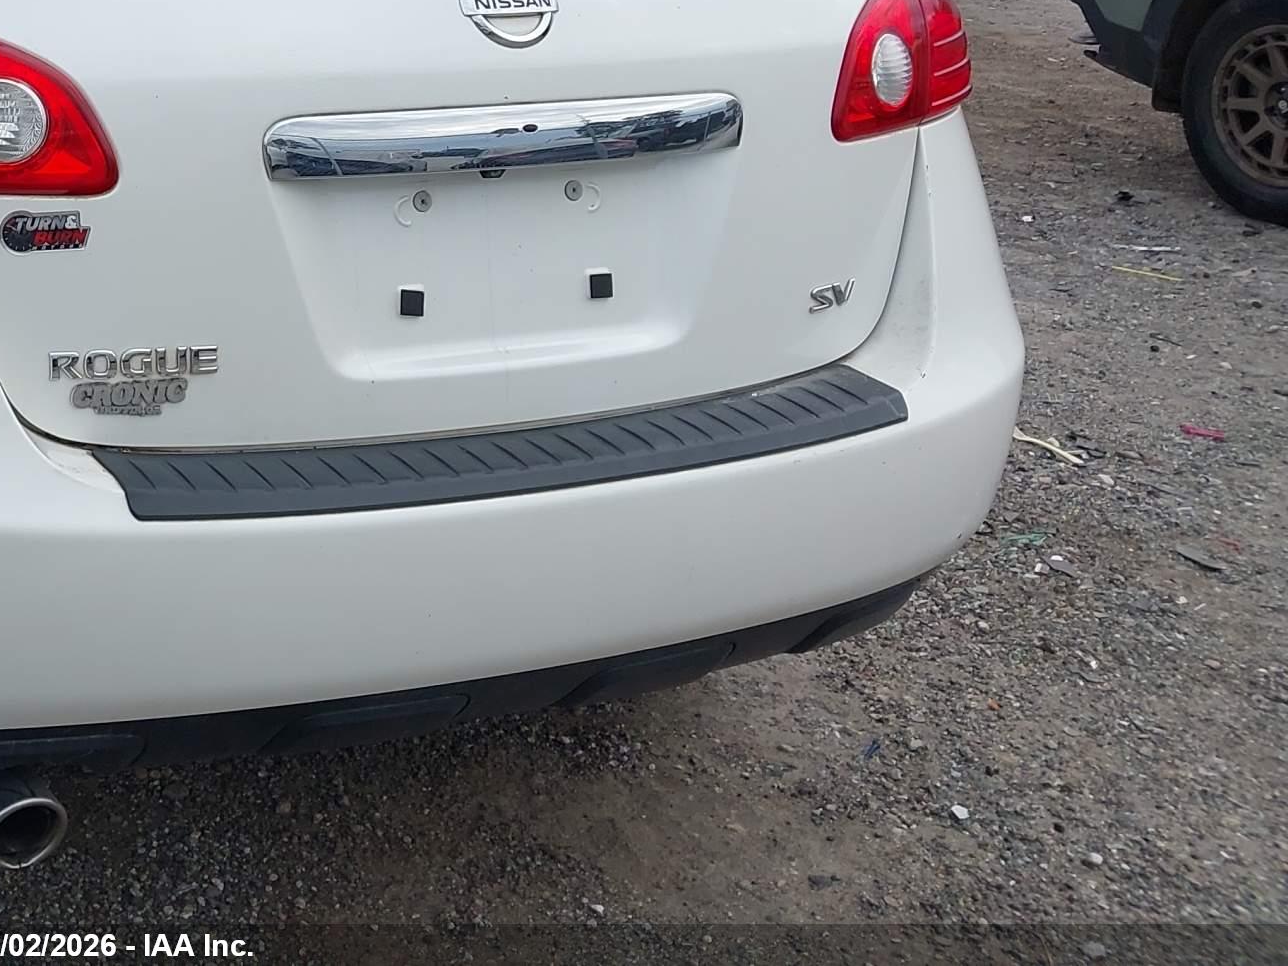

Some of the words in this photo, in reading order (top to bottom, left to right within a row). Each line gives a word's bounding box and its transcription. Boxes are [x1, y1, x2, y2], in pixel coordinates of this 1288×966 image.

[34, 229, 88, 246] BURN
[809, 278, 856, 314] SV
[48, 345, 218, 381] ROGUE
